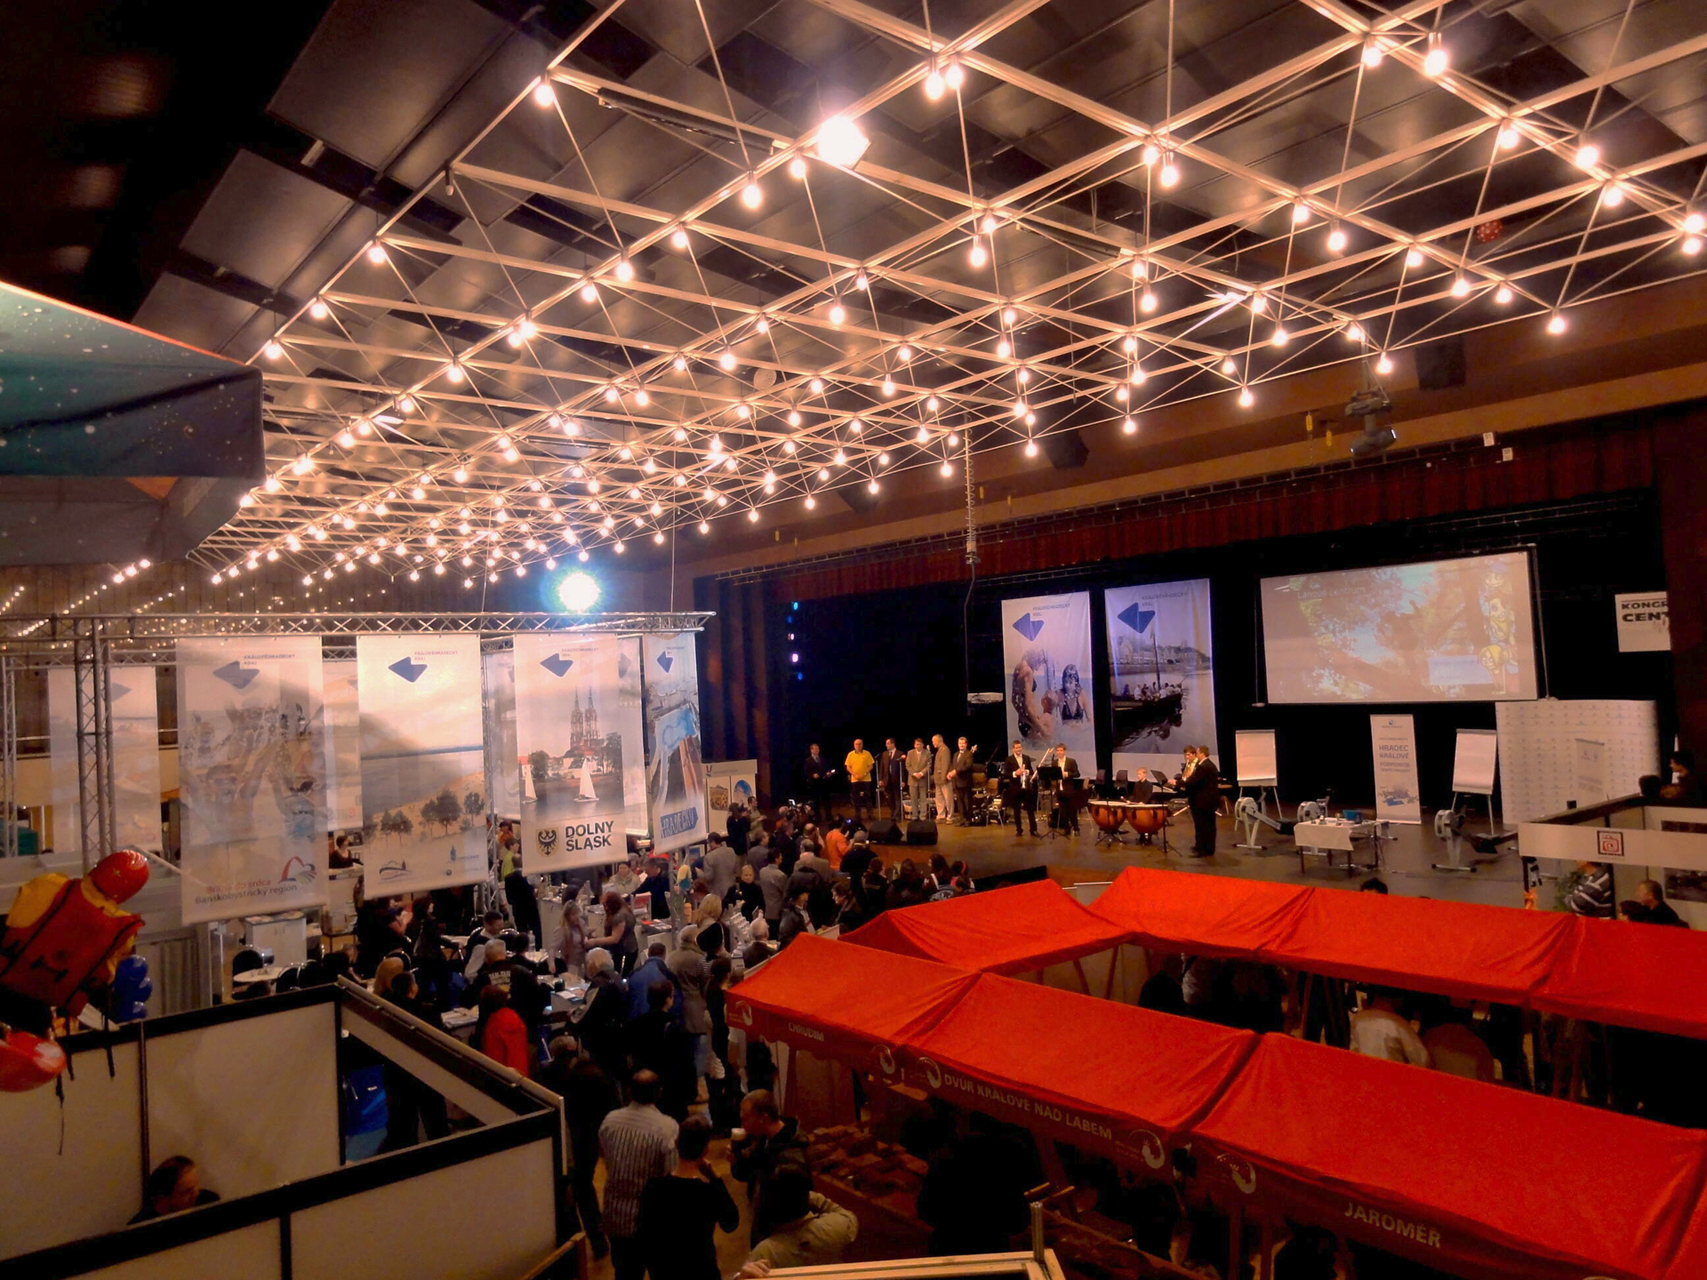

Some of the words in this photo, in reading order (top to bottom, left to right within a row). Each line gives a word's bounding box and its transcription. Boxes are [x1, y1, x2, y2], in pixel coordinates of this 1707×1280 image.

[1378, 744, 1409, 752] HRADEC
[565, 820, 614, 838] DOLNY
[1034, 1102, 1062, 1122] NAD
[1065, 1112, 1112, 1141] LABEM
